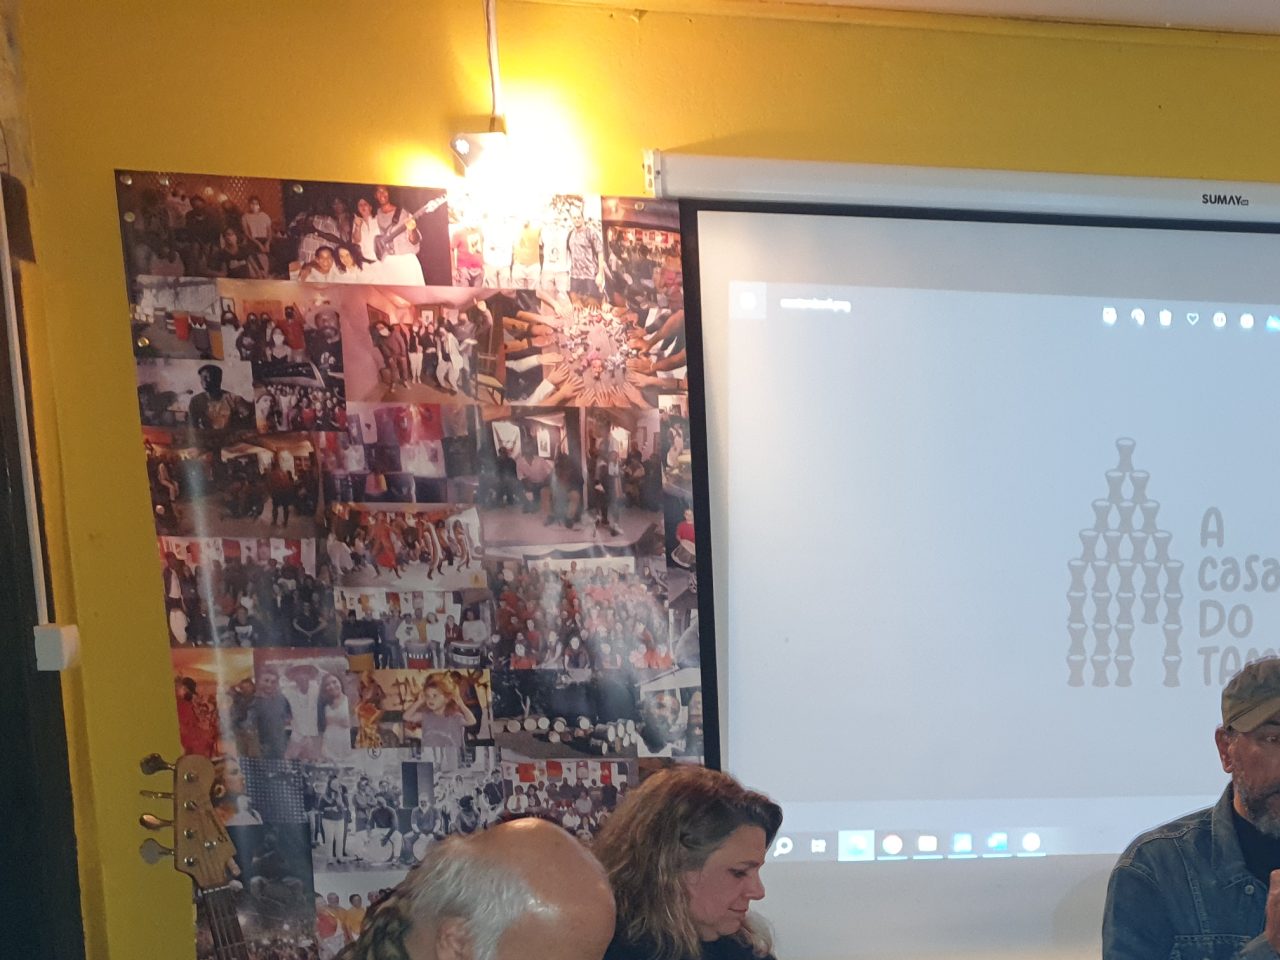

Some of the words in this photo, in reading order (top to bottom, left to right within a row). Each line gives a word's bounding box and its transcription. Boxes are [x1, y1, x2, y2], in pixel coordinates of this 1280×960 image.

[1202, 194, 1242, 205] SUMAY
[1201, 506, 1224, 548] A
[1198, 600, 1253, 638] DO
